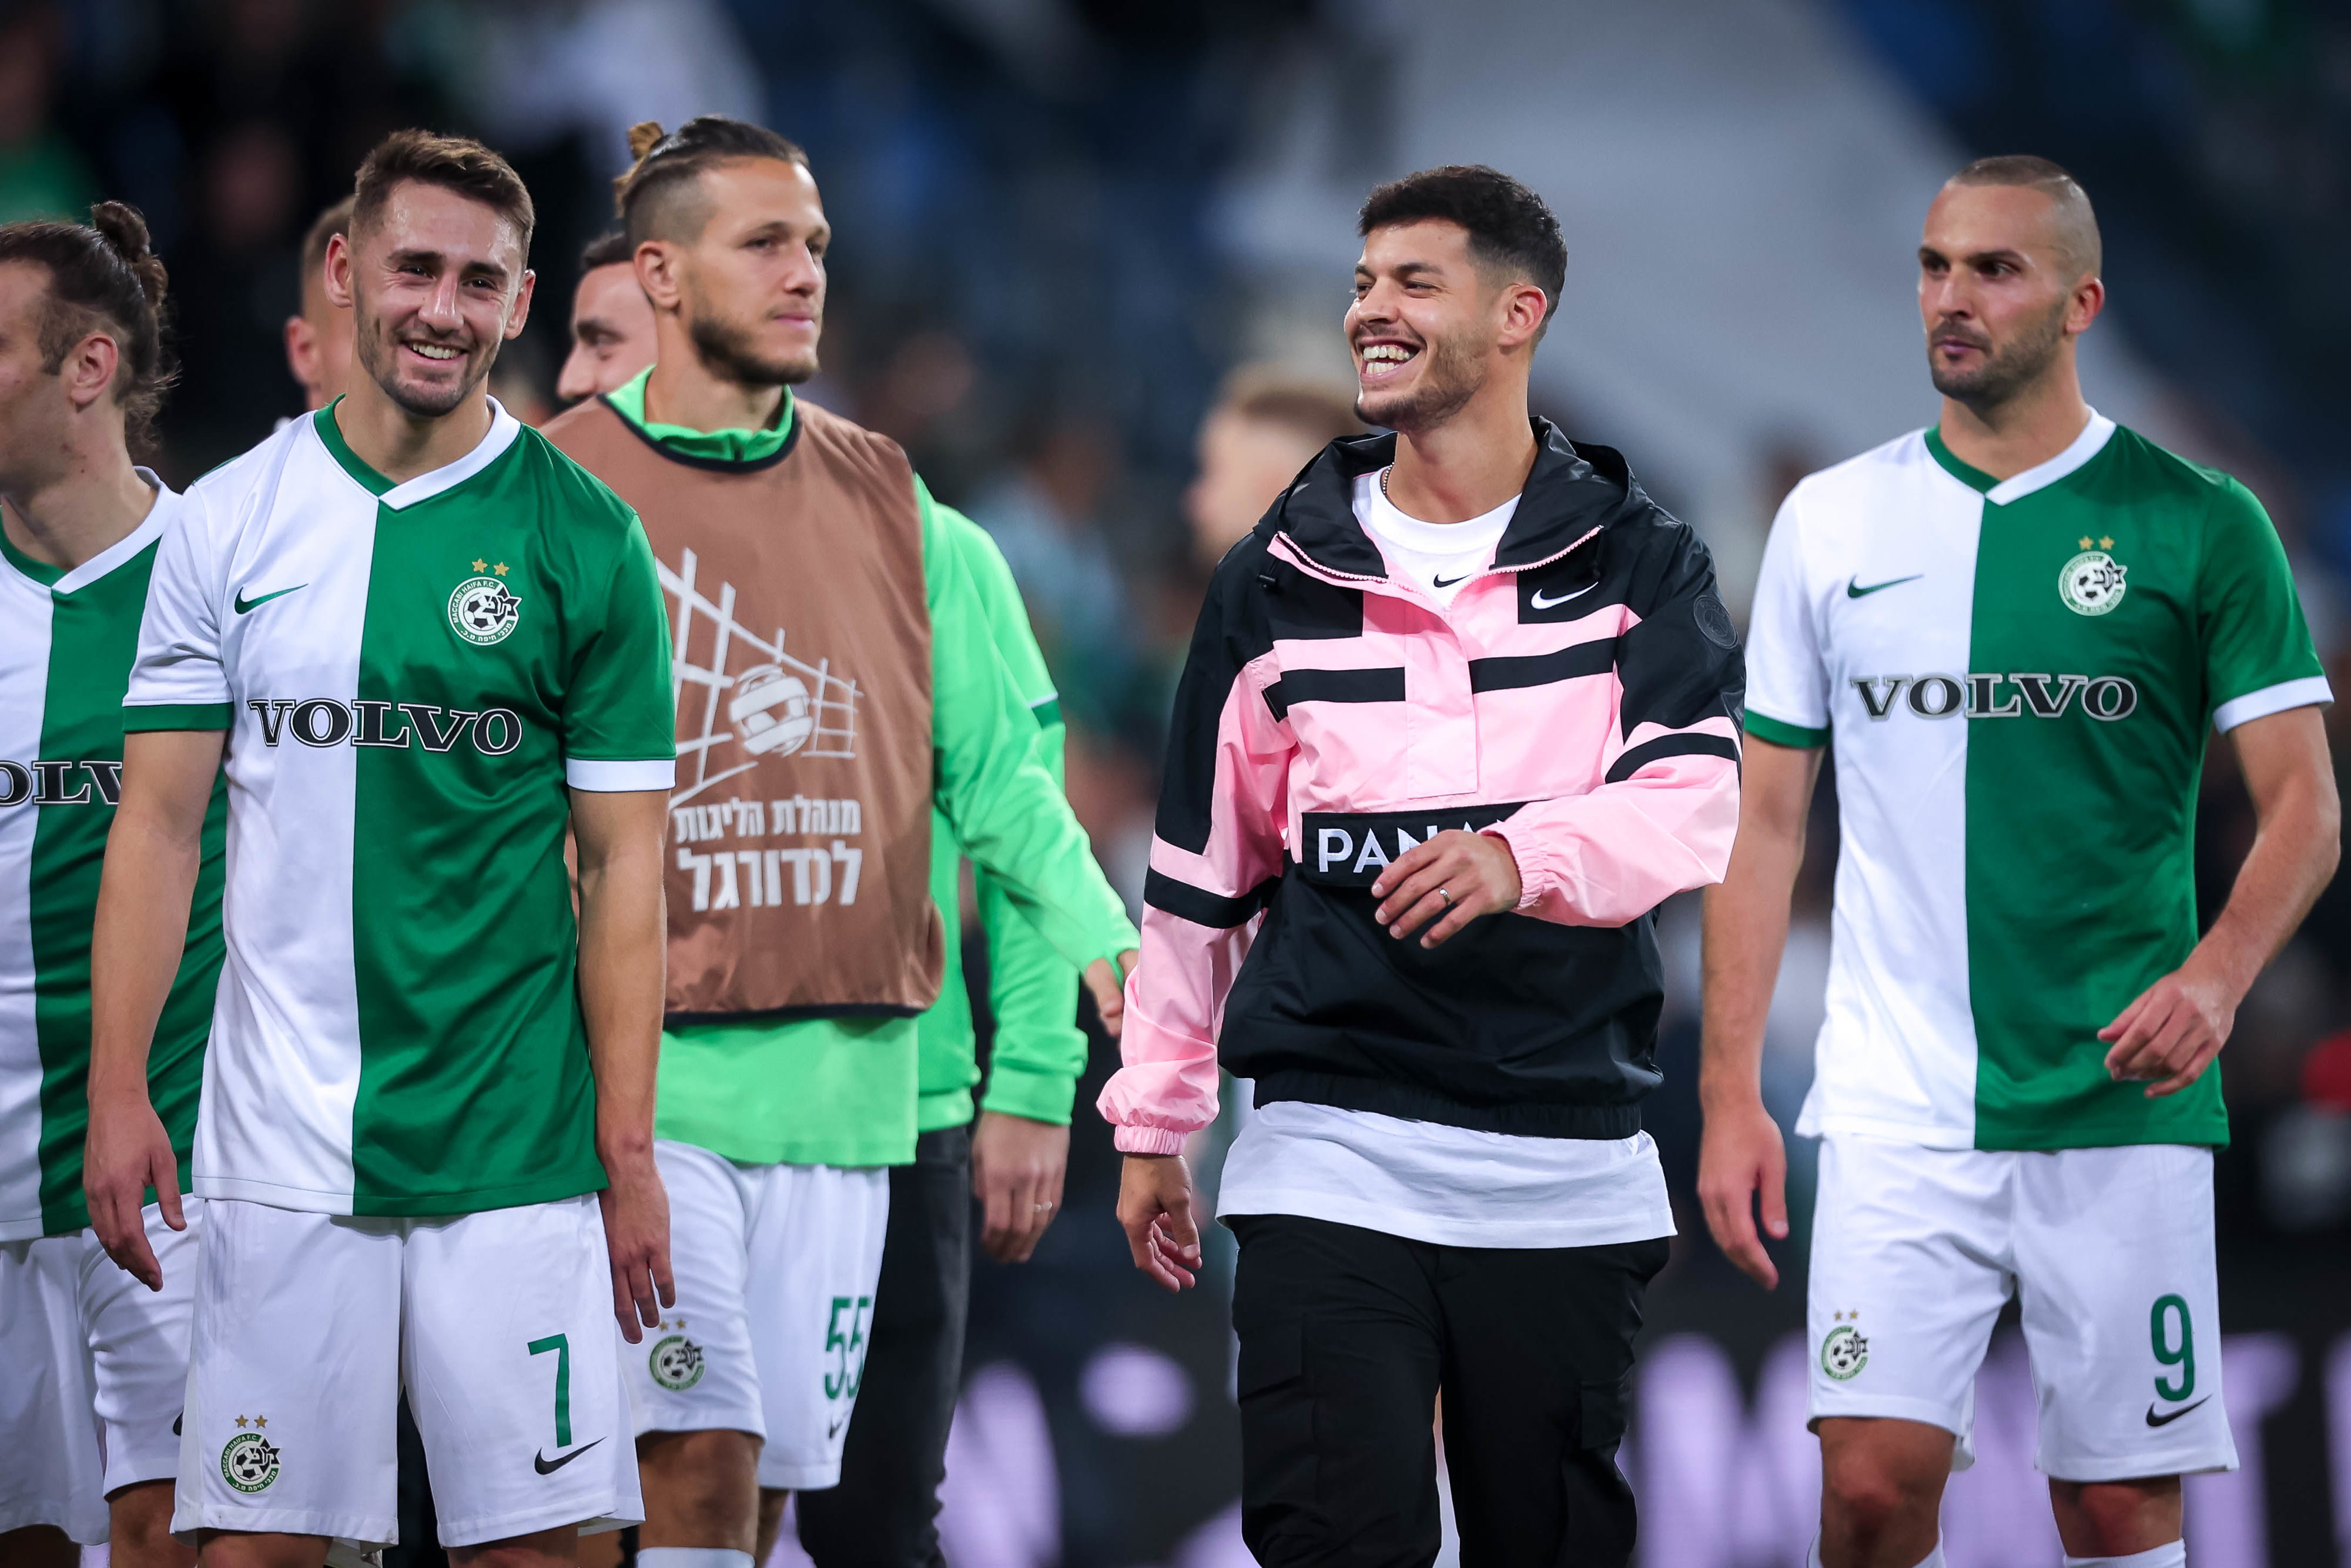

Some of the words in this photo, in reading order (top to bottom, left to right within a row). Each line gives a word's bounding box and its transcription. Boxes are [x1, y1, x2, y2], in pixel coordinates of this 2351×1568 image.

[452, 592, 463, 623] MACCABI
[462, 581, 482, 593] HAIFA
[1850, 673, 2136, 721] VOLVO
[248, 698, 523, 756] VOLVO
[674, 797, 765, 843] הליגות
[771, 794, 862, 835] מנהלת
[678, 840, 862, 912] לכדורגל
[825, 1296, 870, 1399] 55
[2151, 1293, 2194, 1402] 9
[528, 1333, 572, 1448] 7
